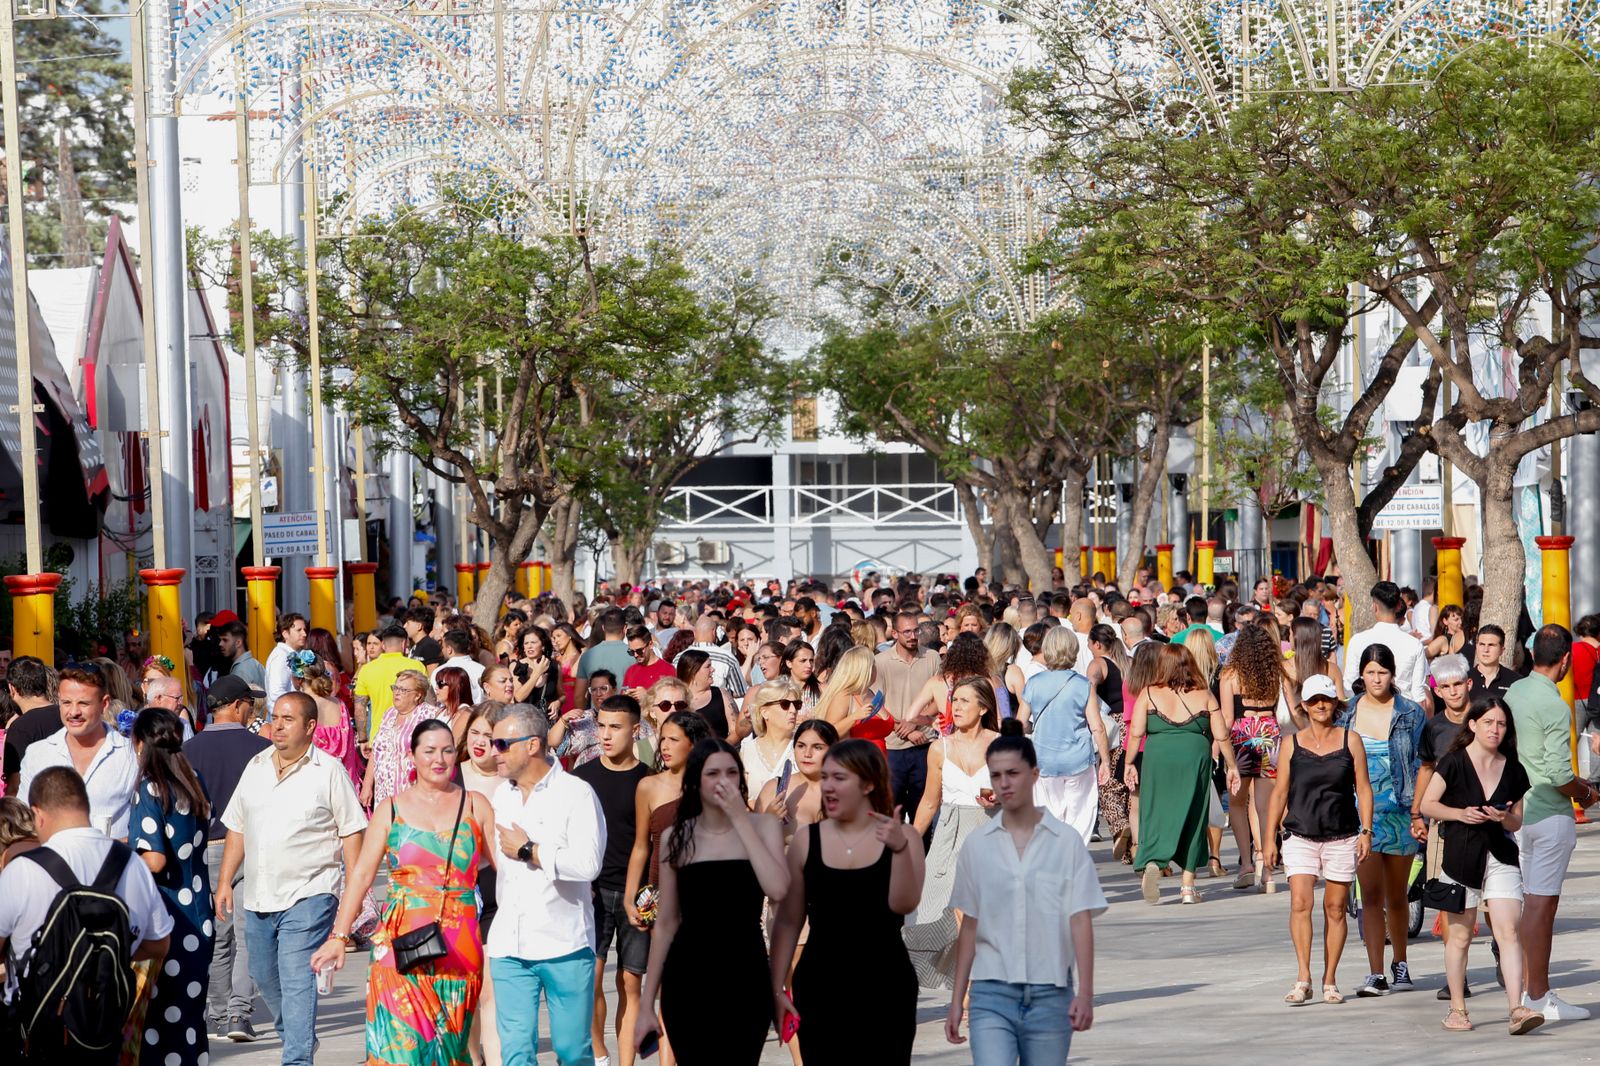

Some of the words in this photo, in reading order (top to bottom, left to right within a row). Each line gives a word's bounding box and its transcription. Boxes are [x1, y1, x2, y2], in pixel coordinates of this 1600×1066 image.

[280, 514, 312, 523] ATENCIÓN
[264, 531, 285, 539] PASEO
[296, 530, 319, 538] CABAL
